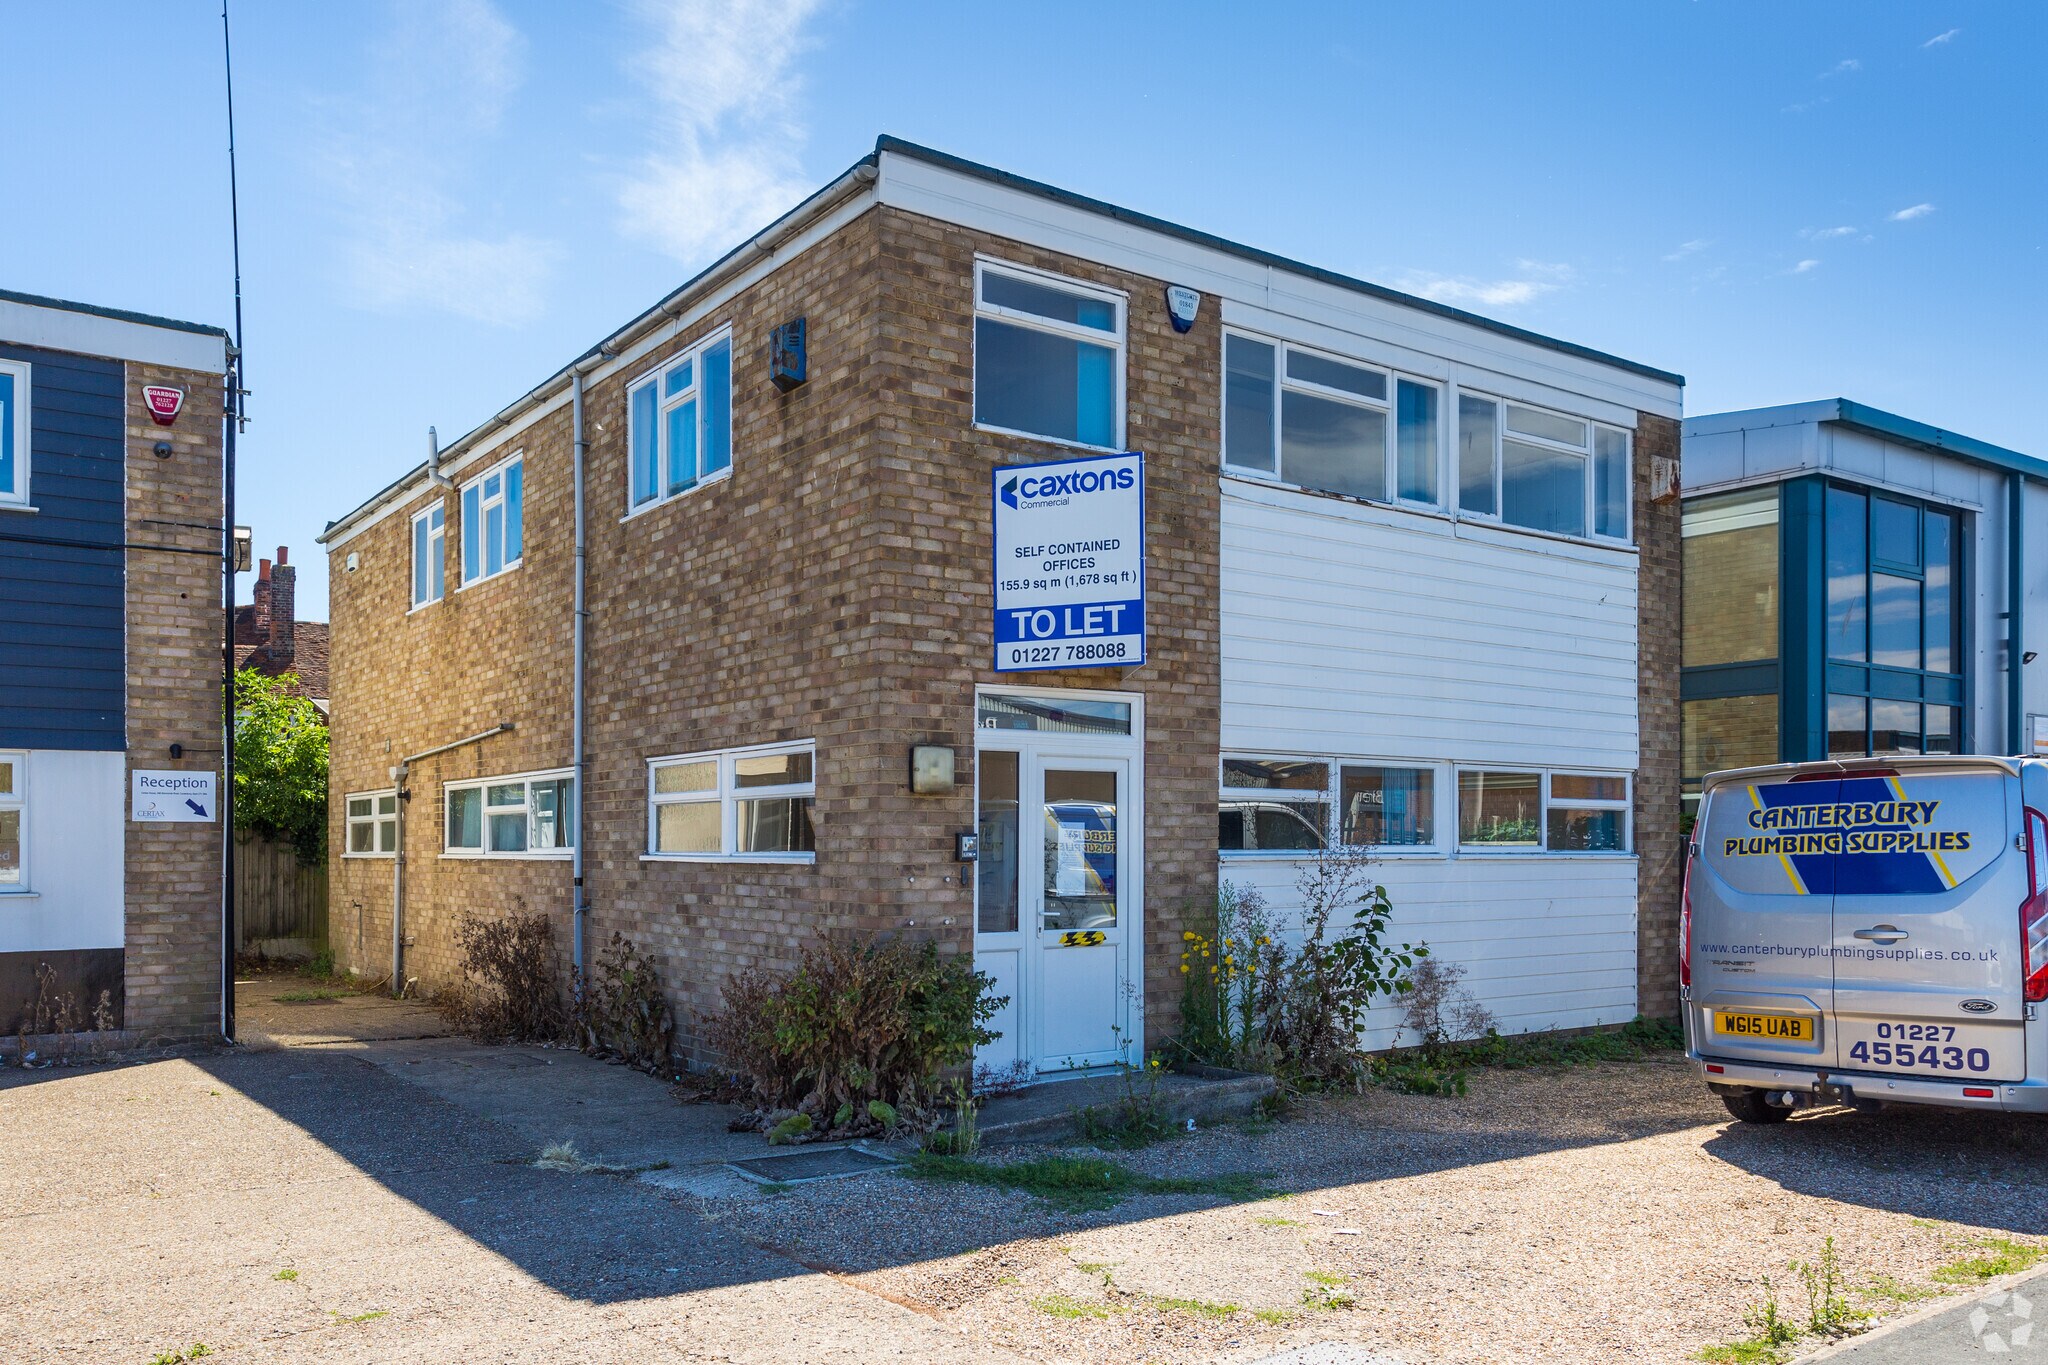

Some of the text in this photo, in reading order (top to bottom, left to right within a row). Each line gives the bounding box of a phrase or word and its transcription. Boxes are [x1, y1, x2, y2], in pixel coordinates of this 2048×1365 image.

[148, 389, 180, 398] GUARDIAN
[1020, 468, 1134, 498] caxtons
[1020, 498, 1070, 510] Commercial
[1015, 538, 1120, 558] SELF CONTAINED
[1042, 557, 1096, 572] OFFICES
[1000, 578, 1030, 591] 155.9
[1033, 580, 1047, 590] sq
[1050, 577, 1061, 588] m
[1064, 573, 1100, 588] (1,678
[1103, 573, 1118, 584] sq
[1120, 570, 1130, 582] ft
[1011, 604, 1126, 638] TO LET
[1012, 642, 1126, 664] 01227 788088
[140, 776, 208, 790] Reception
[1748, 800, 1941, 831] CANTERBURY
[1725, 830, 1972, 857] PLUMBING SUPPLIES
[1700, 944, 1998, 963] www.canterburyplumbingsupplies.co.uk
[1726, 1016, 1801, 1037] WG15 UAB
[1877, 1022, 1956, 1042] 01227
[1850, 1041, 1990, 1072] 455430
